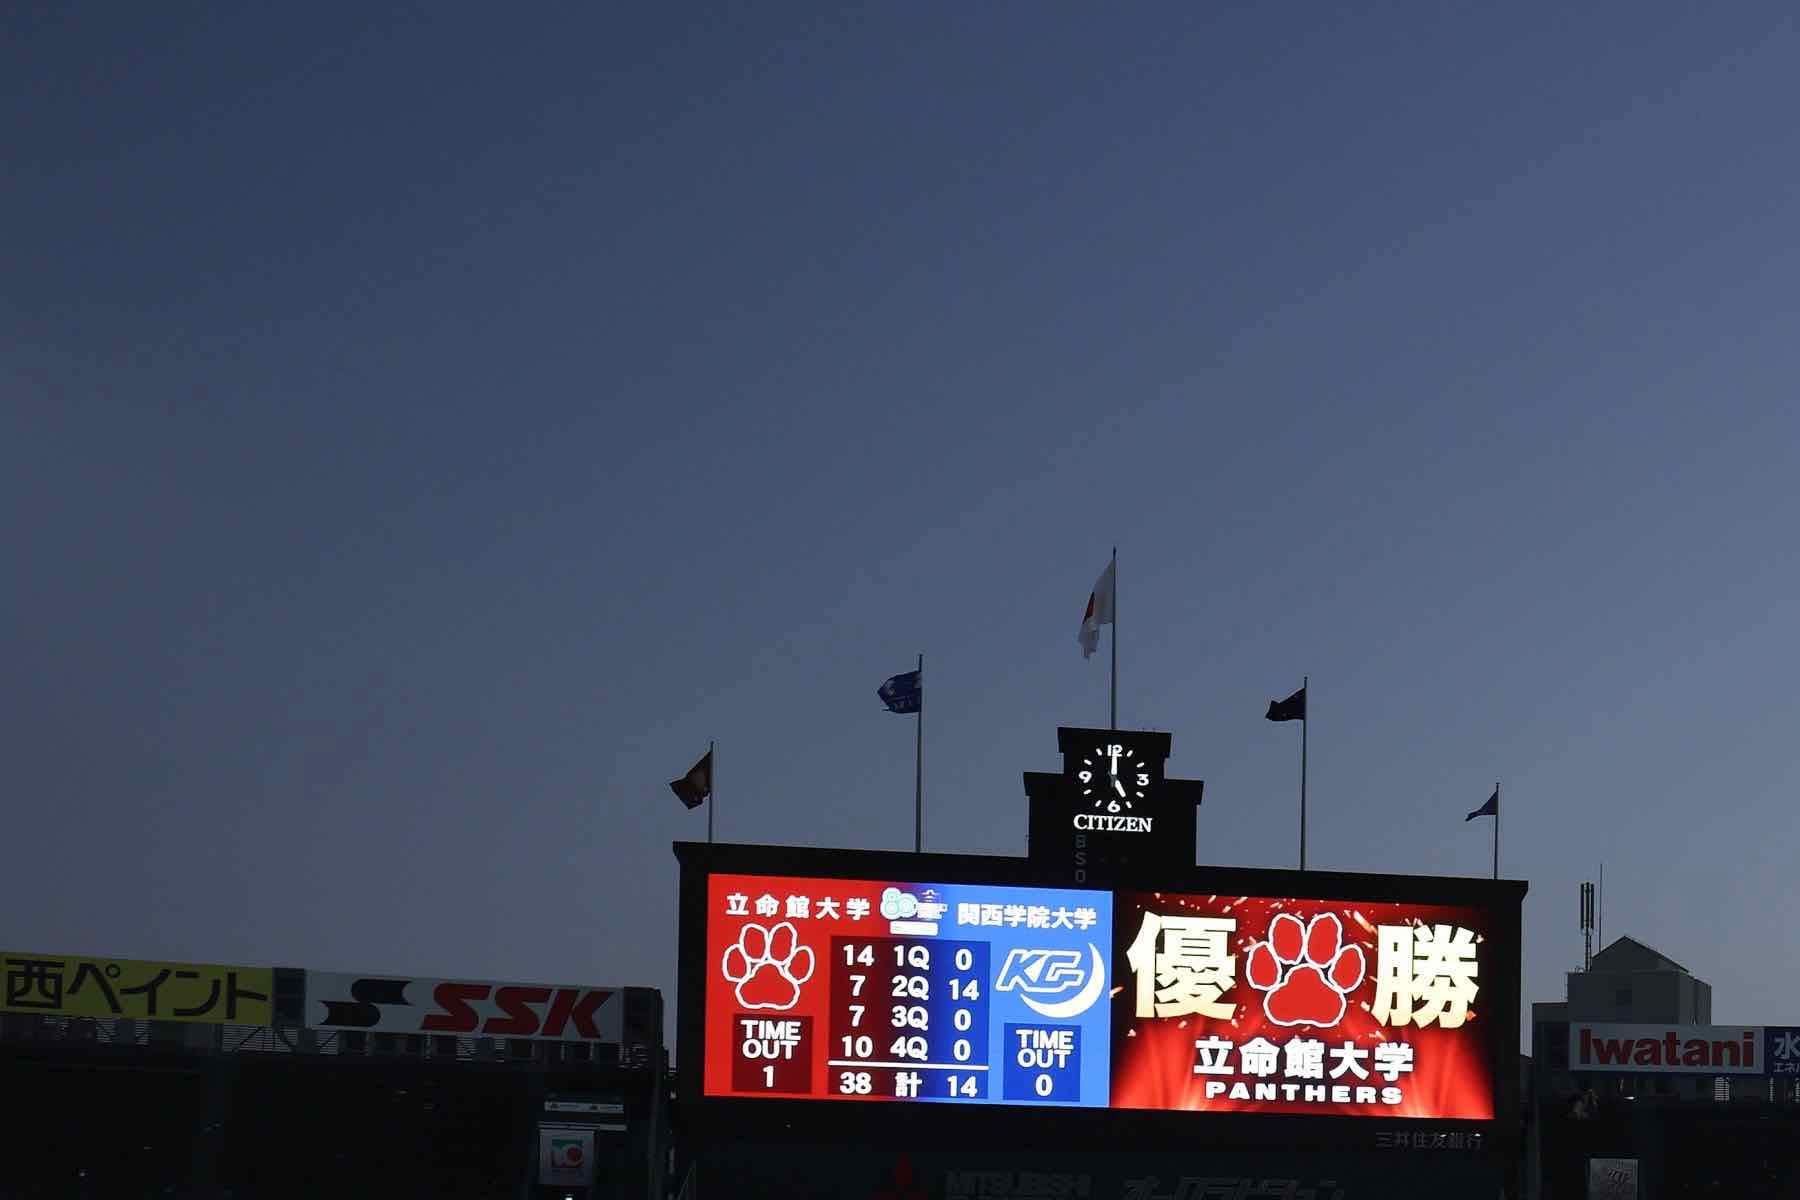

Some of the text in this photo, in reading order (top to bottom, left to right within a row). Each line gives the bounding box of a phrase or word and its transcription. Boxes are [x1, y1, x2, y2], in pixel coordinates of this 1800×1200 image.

[1107, 744, 1123, 757] 12
[1078, 771, 1149, 786] 9 3
[1107, 800, 1121, 812] 6
[1073, 814, 1152, 832] CITIZEN
[726, 892, 871, 920] 立命館大学
[957, 903, 1097, 930] 関西学院大学
[843, 944, 973, 971] 14 1Q 0
[1127, 911, 1480, 1029] 優 勝
[5, 957, 268, 1020] 西ペイント
[849, 975, 979, 1001] 7 2Q 14
[422, 983, 614, 1038] SSK
[849, 1006, 972, 1031] 7 3Q 0
[740, 1019, 801, 1041] TIME
[1015, 1029, 1074, 1050] TIME
[742, 1039, 799, 1060] OUT
[842, 1035, 971, 1061] 10 4Q 0
[1017, 1049, 1072, 1068] OUT
[1193, 1036, 1415, 1081] 立命館大学
[1579, 1028, 1755, 1067] Iwatani
[763, 1066, 774, 1087] 1
[839, 1072, 978, 1098] 38 計 14
[1035, 1074, 1053, 1096] 0
[1205, 1081, 1404, 1105] PANTHERS
